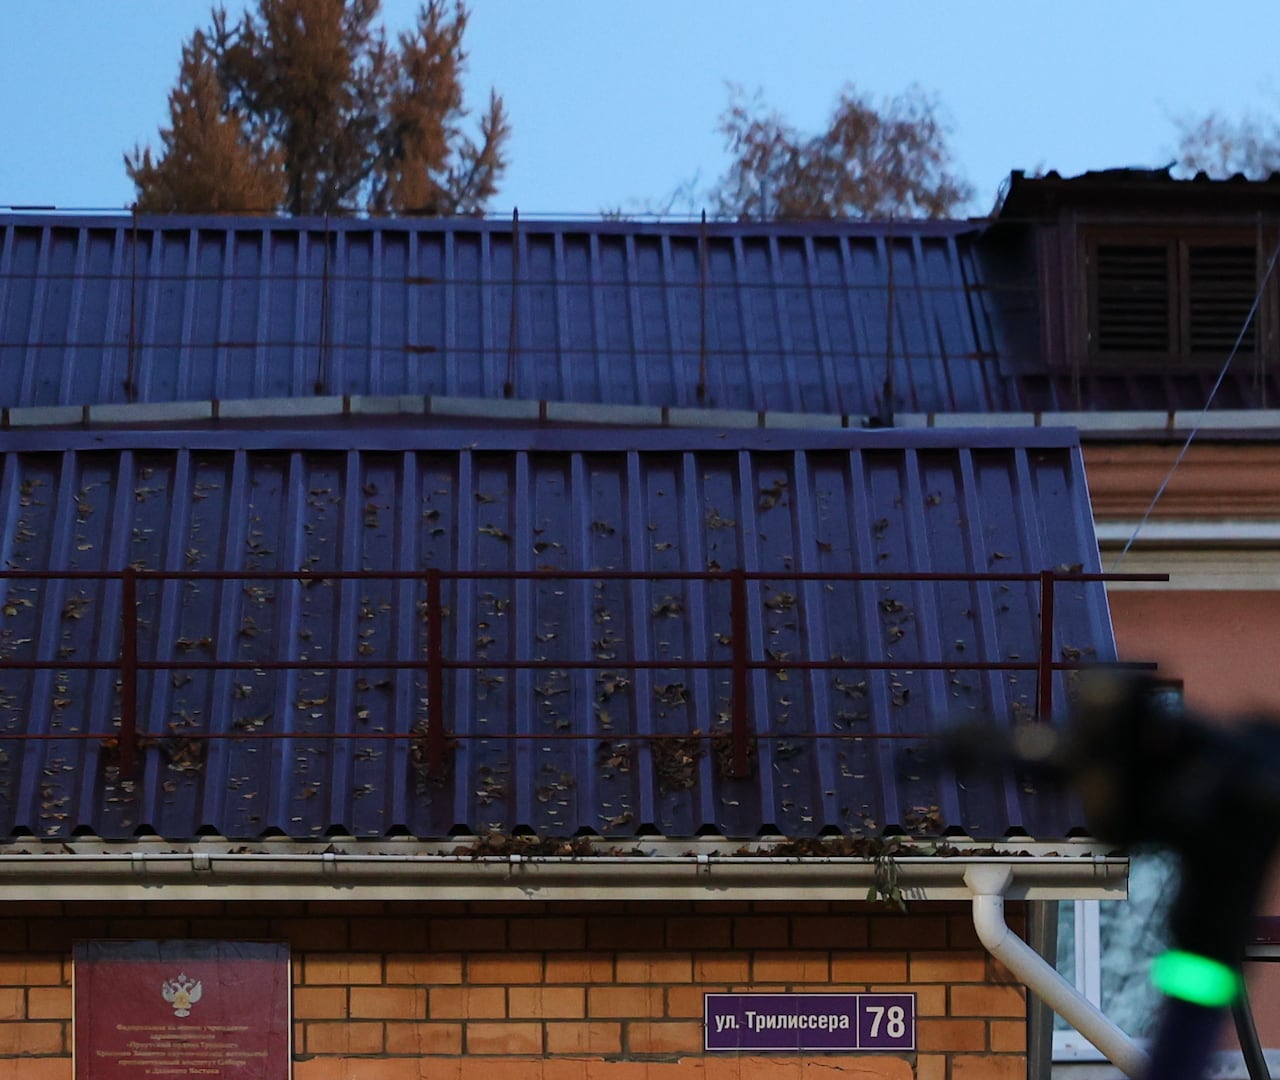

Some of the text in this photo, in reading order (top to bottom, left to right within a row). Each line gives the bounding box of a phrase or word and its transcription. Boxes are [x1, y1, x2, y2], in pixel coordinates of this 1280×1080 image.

[715, 1006, 906, 1038] ул. Трилиссера 78
